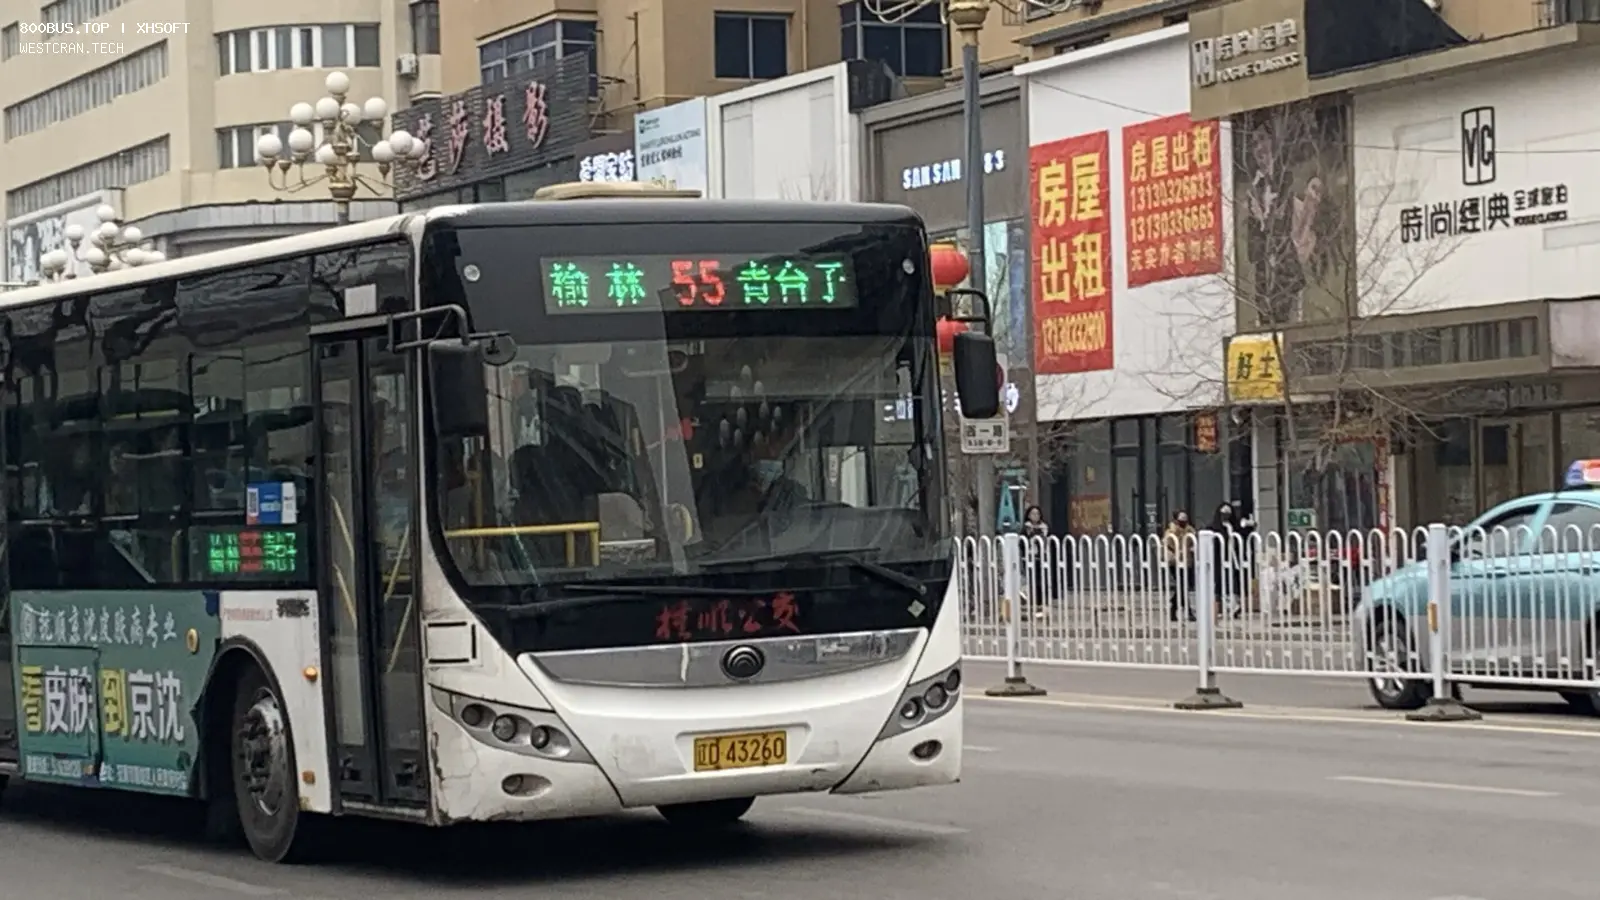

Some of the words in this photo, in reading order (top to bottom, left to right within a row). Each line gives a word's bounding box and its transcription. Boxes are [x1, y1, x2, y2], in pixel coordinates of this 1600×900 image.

[1130, 125, 1212, 182] 房屋出租
[1038, 151, 1103, 227] 房屋
[1400, 192, 1510, 243] 時尚經典
[670, 260, 725, 306] 55
[1041, 231, 1106, 304] 出租
